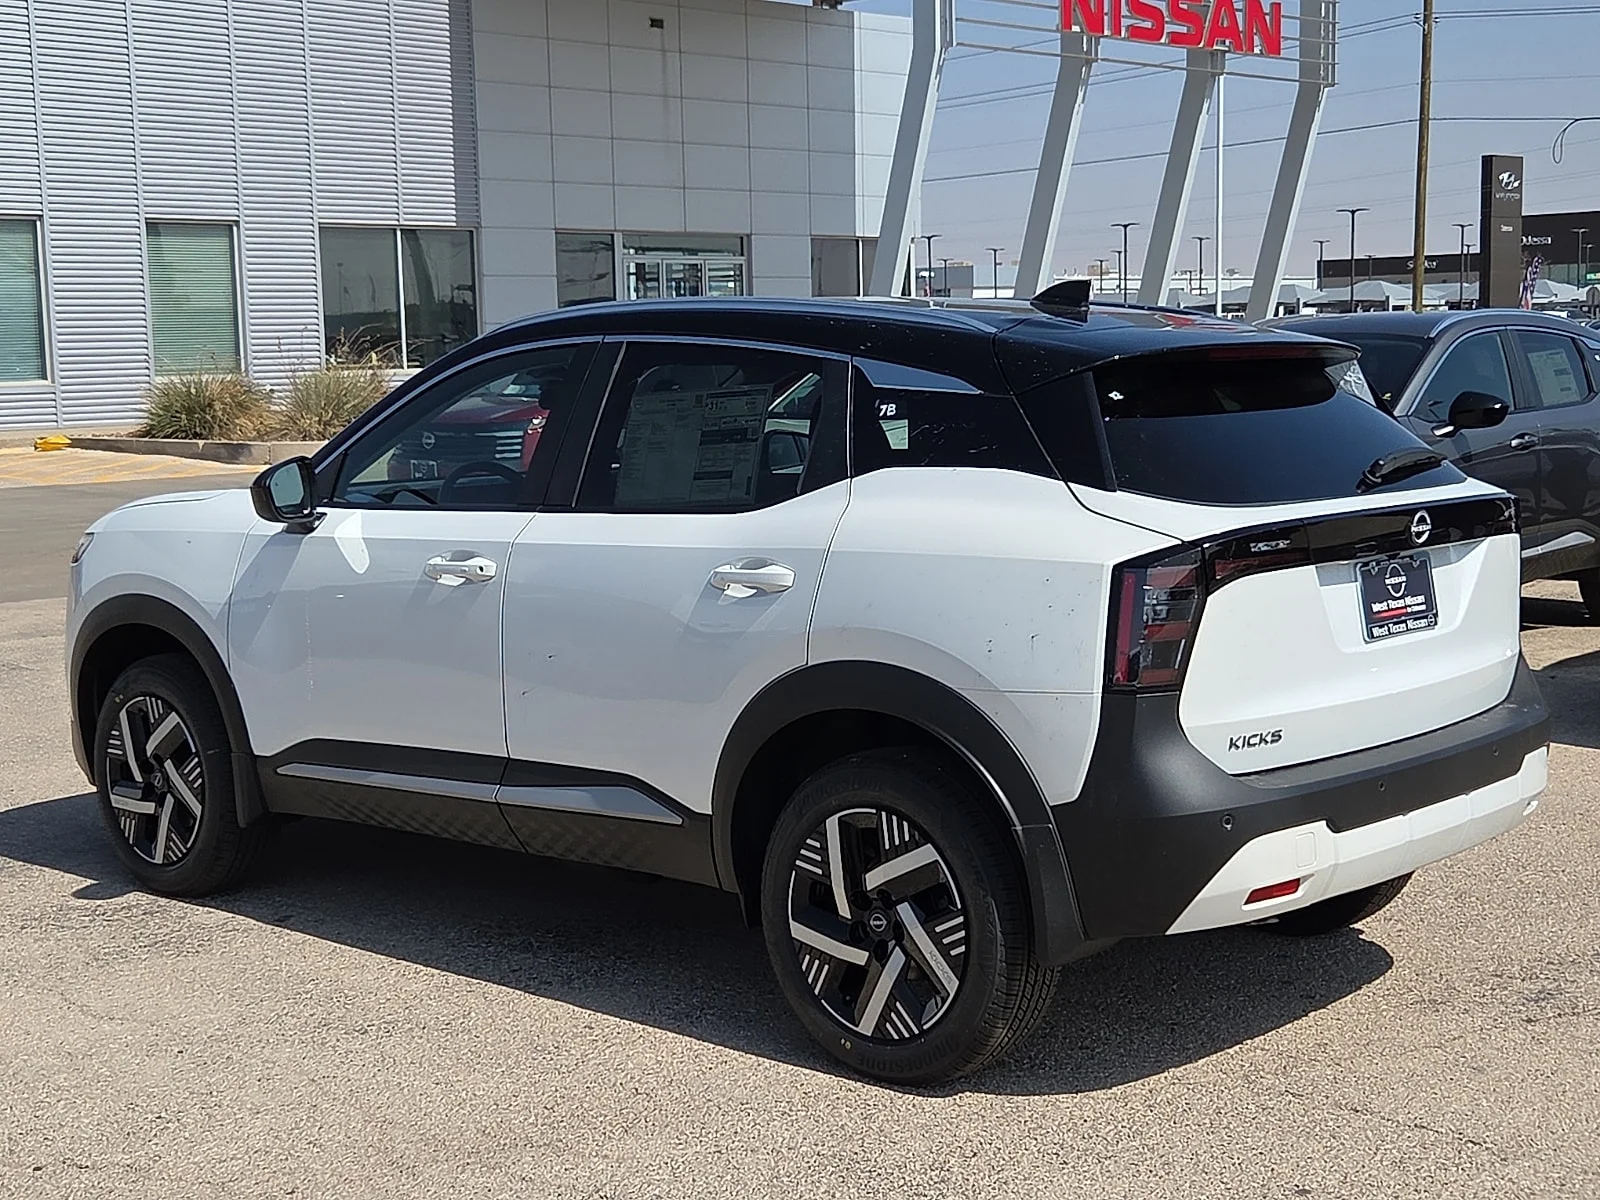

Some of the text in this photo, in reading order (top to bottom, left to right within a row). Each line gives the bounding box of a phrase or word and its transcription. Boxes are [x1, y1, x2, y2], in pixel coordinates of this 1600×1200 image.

[1060, 0, 1282, 56] NISSAN
[1371, 601, 1388, 612] West
[1388, 599, 1405, 609] Texas
[1405, 595, 1425, 606] Nissan
[1371, 619, 1429, 637] West Texas Nissan
[1228, 729, 1283, 752] KICKS
